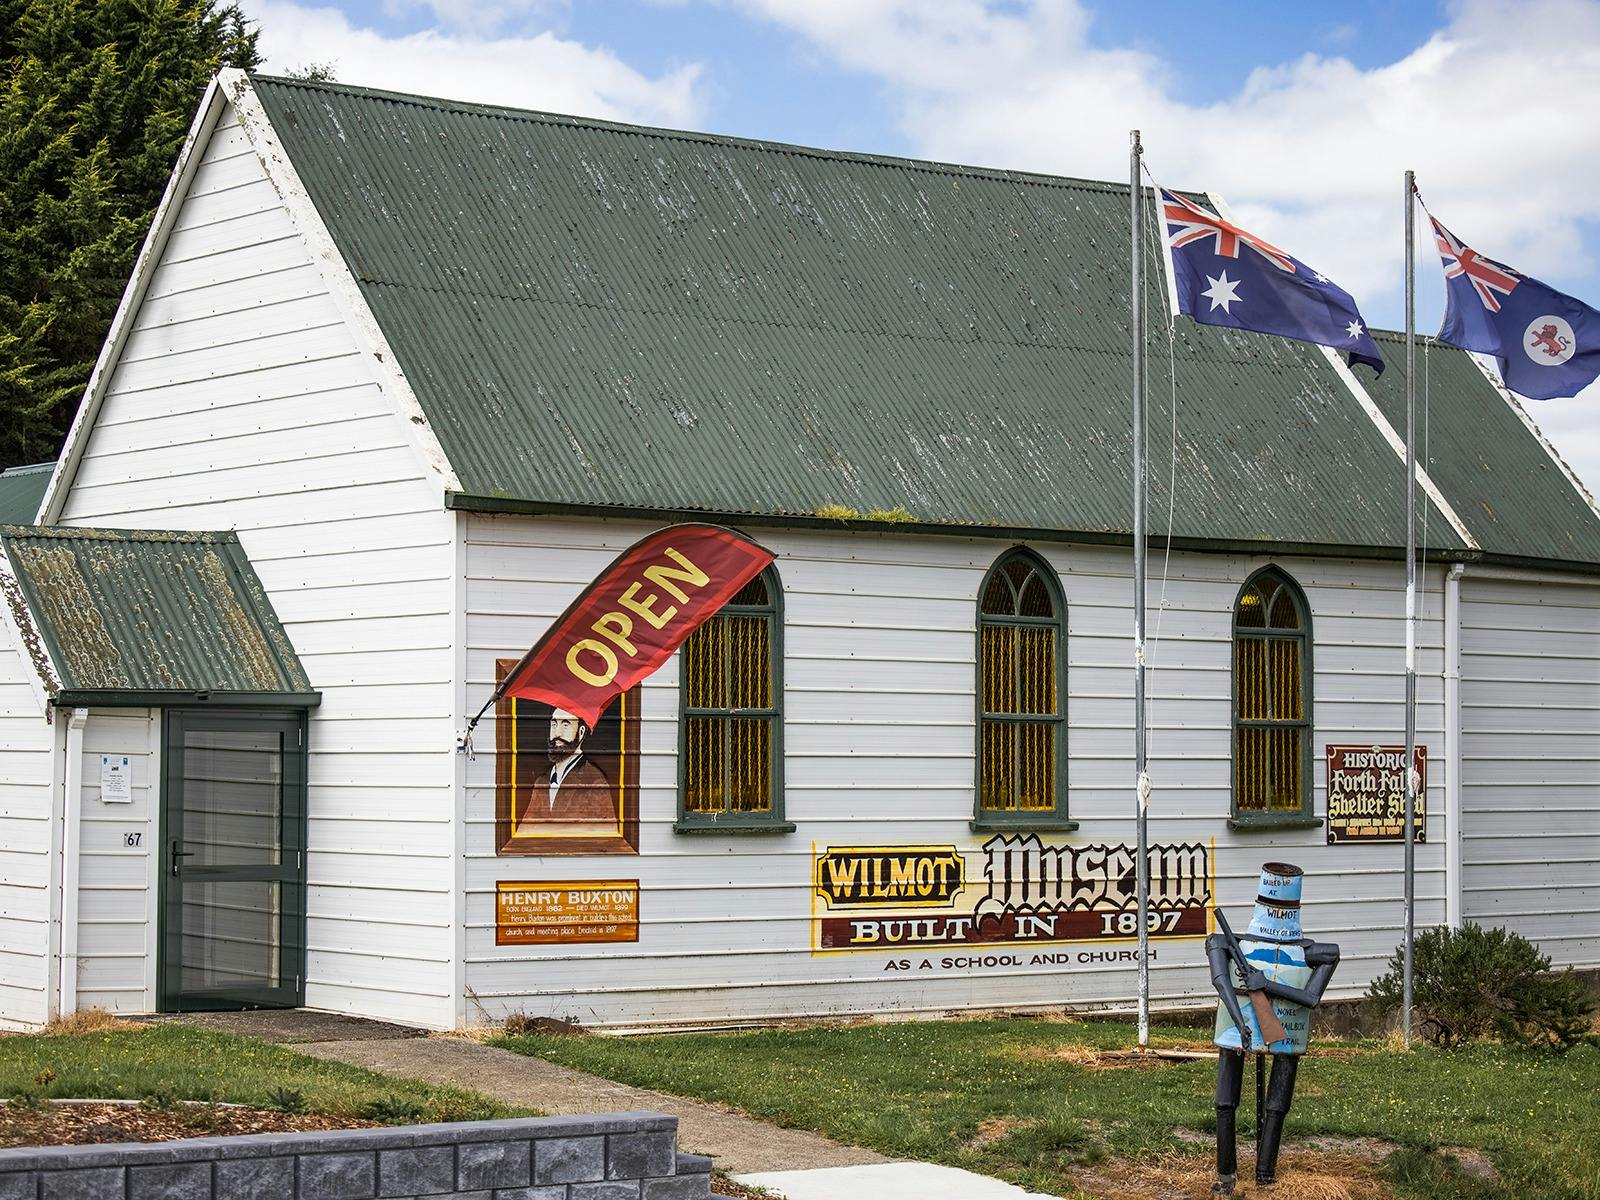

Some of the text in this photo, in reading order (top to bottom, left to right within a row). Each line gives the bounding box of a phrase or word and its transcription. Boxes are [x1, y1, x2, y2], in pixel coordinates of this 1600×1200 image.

[565, 547, 711, 687] OPEN
[1343, 752, 1406, 771] HISTORIC
[1331, 767, 1412, 797] Forth Fal
[1328, 792, 1385, 819] Shelter
[127, 832, 142, 846] 67
[827, 833, 1212, 934] WILMOT Museum
[501, 890, 634, 905] HENRY BUXTON
[1267, 908, 1298, 920] WILMOT
[850, 911, 1182, 943] BUILT IN 1897
[1260, 926, 1280, 936] VALLEY
[884, 950, 1157, 971] AS A SCHOOL AND CHURCH
